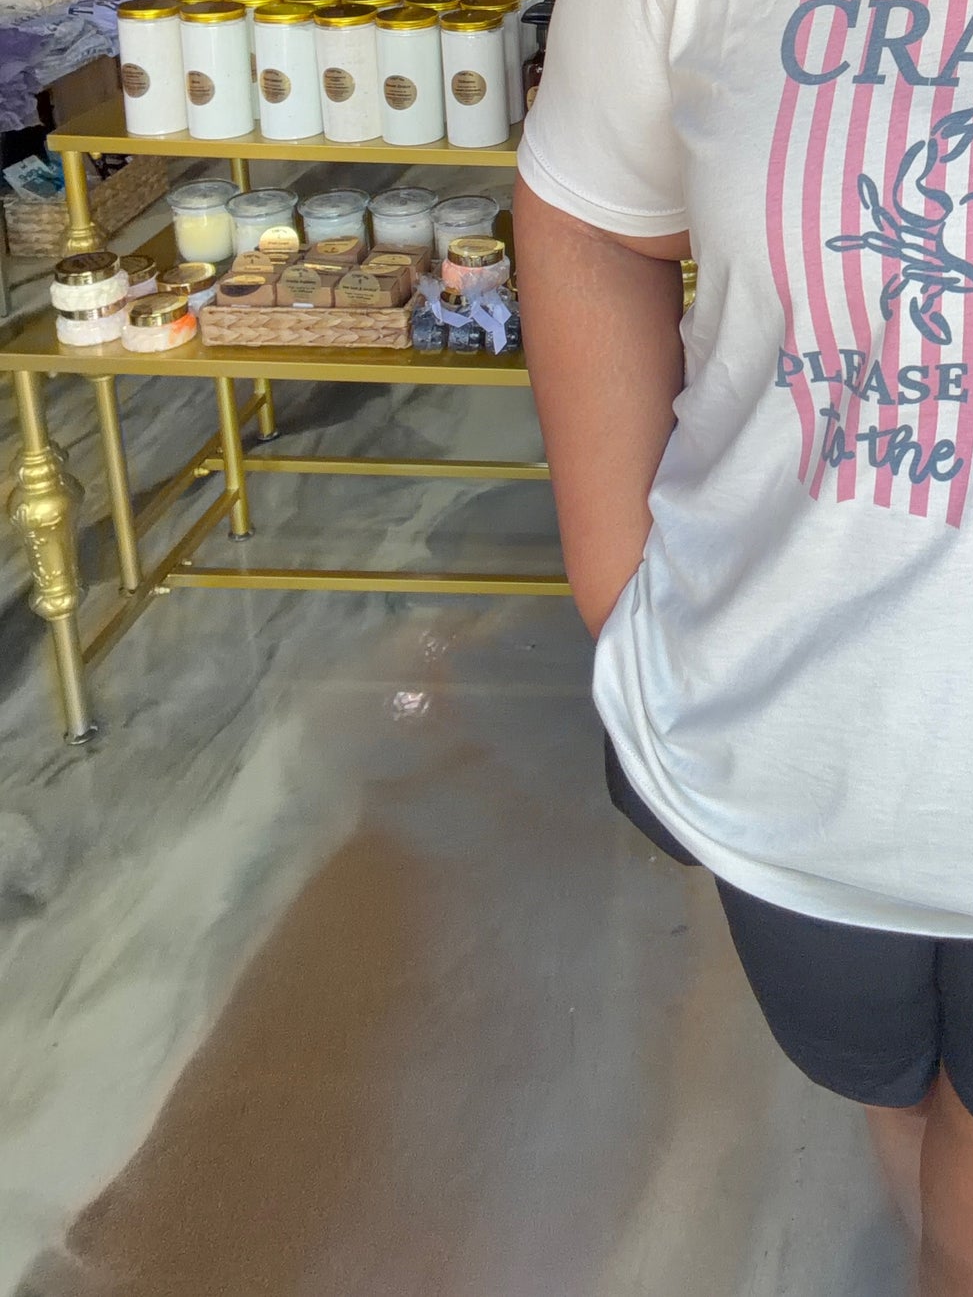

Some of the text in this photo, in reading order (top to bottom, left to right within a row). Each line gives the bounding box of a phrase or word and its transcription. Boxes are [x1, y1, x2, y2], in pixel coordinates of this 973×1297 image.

[774, 345, 969, 406] PLEASE
[819, 403, 855, 468] to
[855, 424, 964, 484] the
